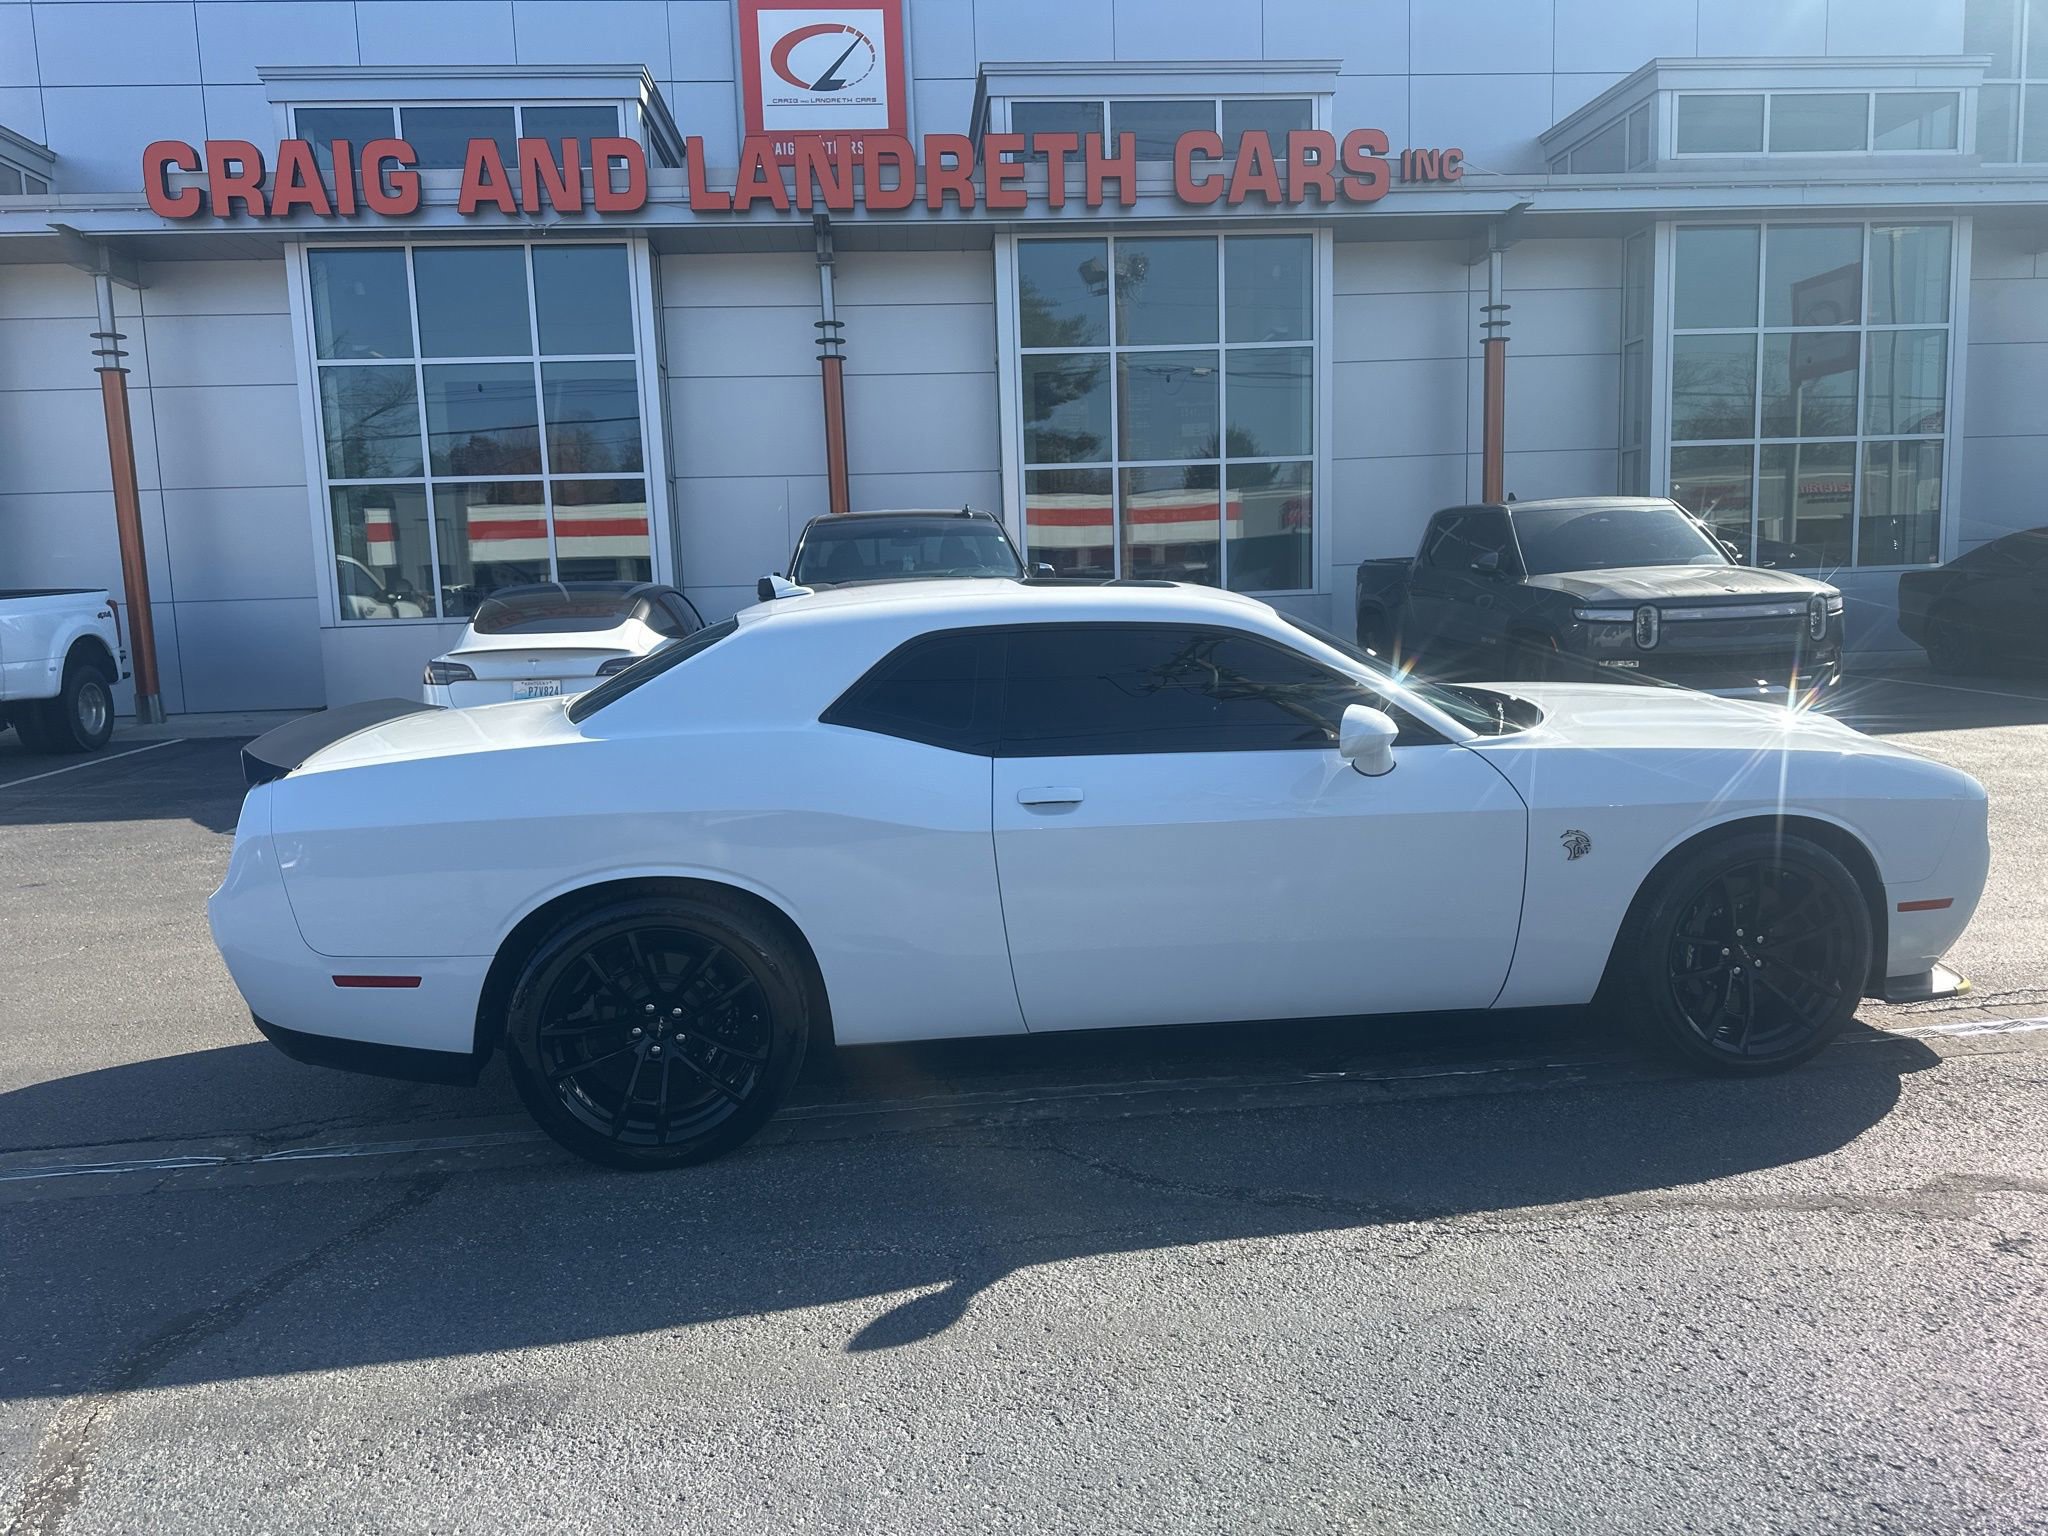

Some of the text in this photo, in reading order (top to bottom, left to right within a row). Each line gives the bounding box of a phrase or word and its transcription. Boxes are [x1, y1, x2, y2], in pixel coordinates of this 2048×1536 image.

[142, 129, 1464, 217] CRAIG AND LANDRETH CARS INC
[528, 686, 559, 697] P7V824
